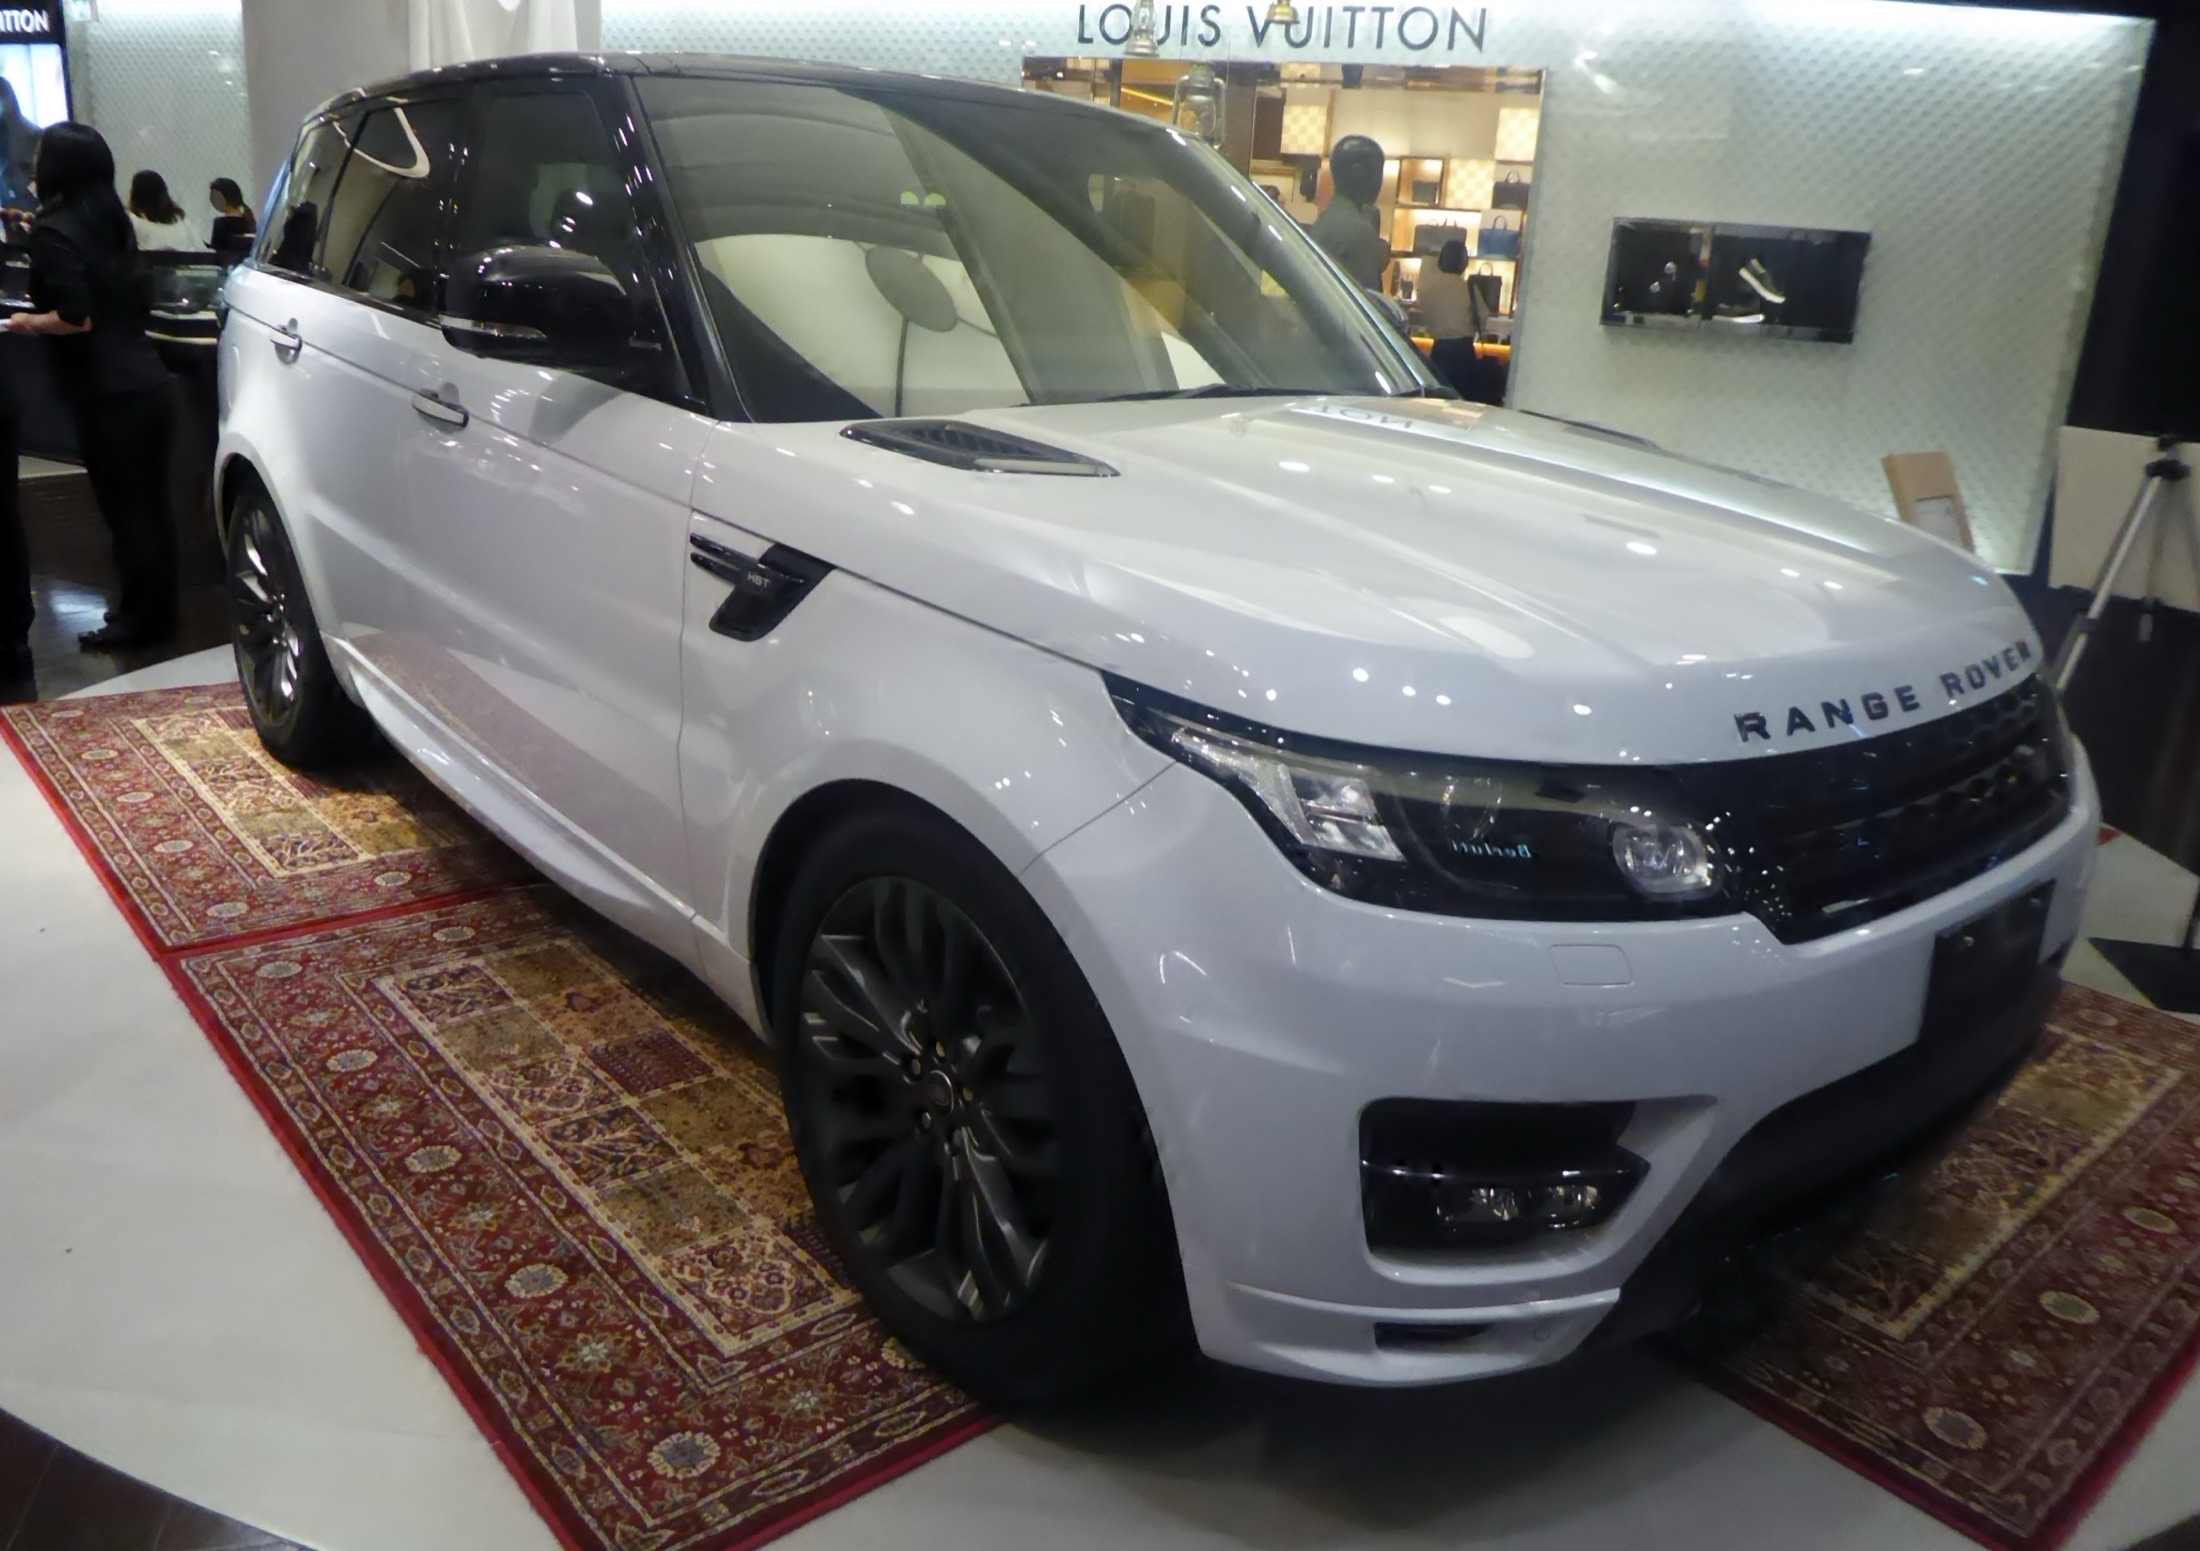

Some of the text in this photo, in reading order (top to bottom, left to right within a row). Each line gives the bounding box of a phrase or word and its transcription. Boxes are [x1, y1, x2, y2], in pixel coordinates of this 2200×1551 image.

[1246, 6, 1487, 51] VUITTON
[746, 571, 770, 588] HST
[1734, 685, 1920, 742] RANGE
